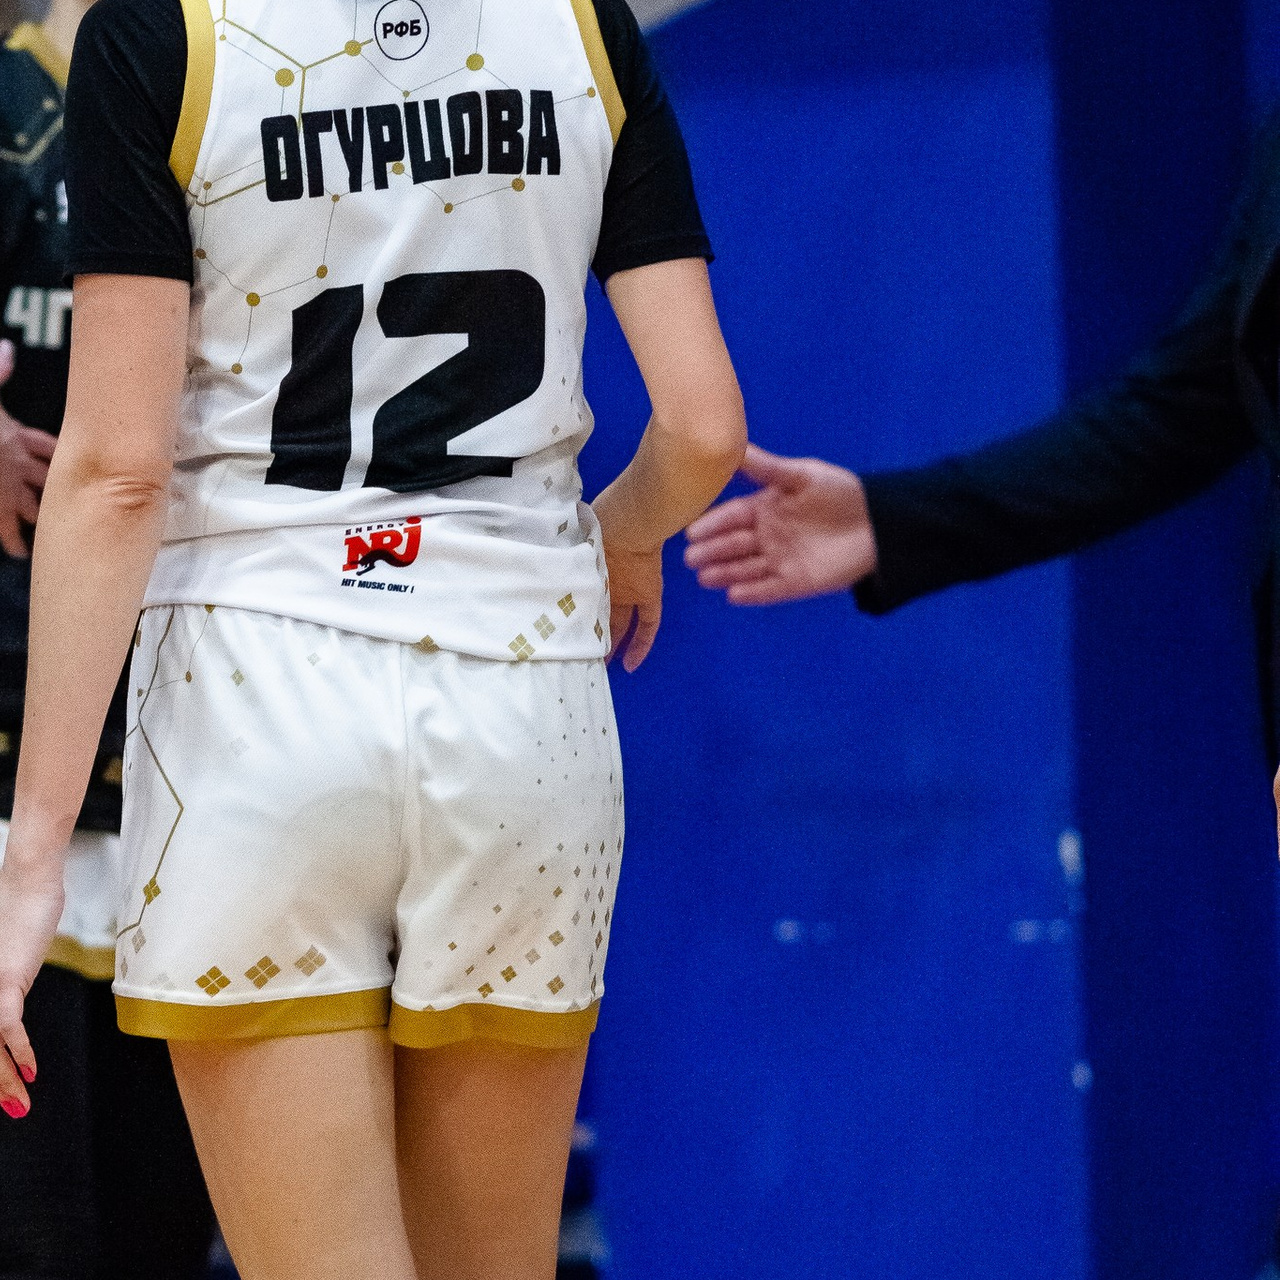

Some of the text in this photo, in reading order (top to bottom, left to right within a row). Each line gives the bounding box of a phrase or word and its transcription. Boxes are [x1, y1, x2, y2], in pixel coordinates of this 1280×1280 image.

[382, 19, 422, 39] РФБ
[260, 88, 561, 202] ОГУРЦОВА
[264, 269, 546, 492] 12
[341, 578, 357, 587] HIT
[357, 580, 386, 590] MUSIC
[387, 583, 409, 593] ONLY
